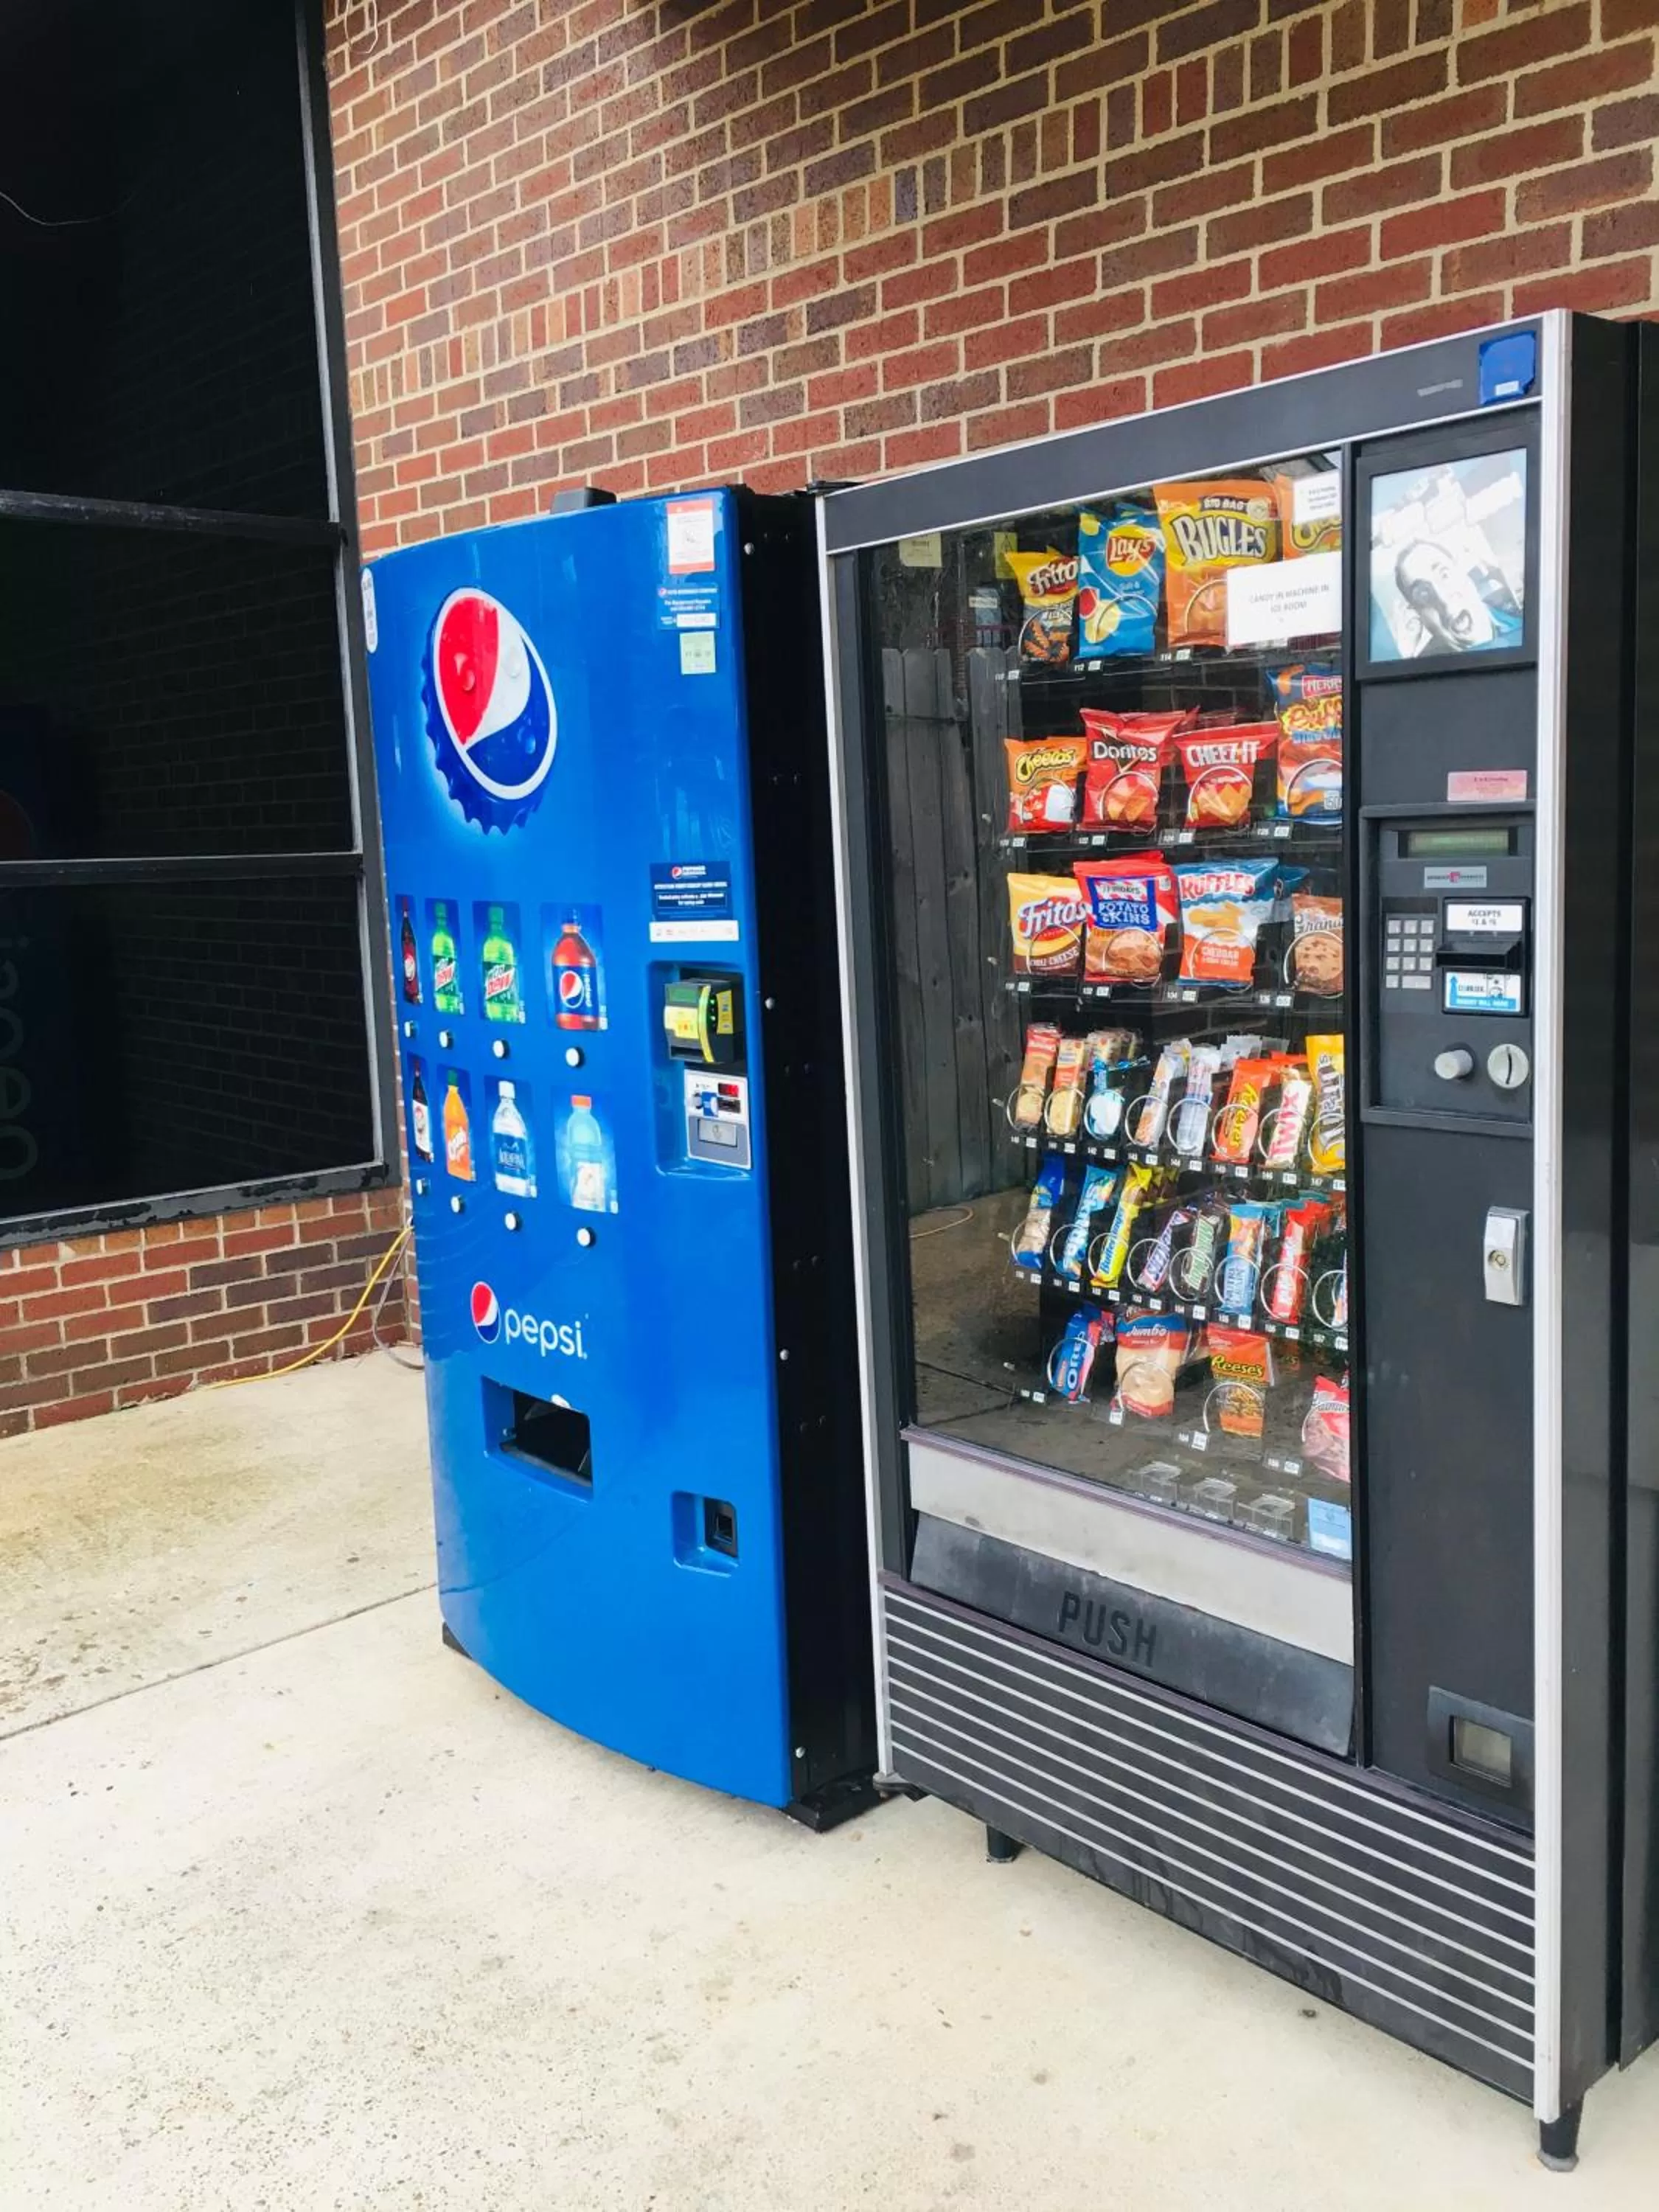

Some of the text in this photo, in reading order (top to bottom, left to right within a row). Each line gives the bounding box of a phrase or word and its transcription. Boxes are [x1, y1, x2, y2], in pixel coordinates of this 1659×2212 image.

[1108, 536, 1158, 563] Lay's
[1172, 515, 1267, 562] BUGLES
[1026, 556, 1079, 597] Frito
[1016, 748, 1074, 781] Cheetos
[1093, 741, 1158, 762] Doritos
[1180, 873, 1255, 898] RUFFLES
[1018, 899, 1087, 939] Fritos
[1098, 901, 1149, 914] POTATO
[504, 1308, 583, 1357] pepsi
[1125, 1323, 1167, 1338] Jumbo
[1211, 1354, 1263, 1377] Reese's
[1058, 1590, 1157, 1668] PUSH
